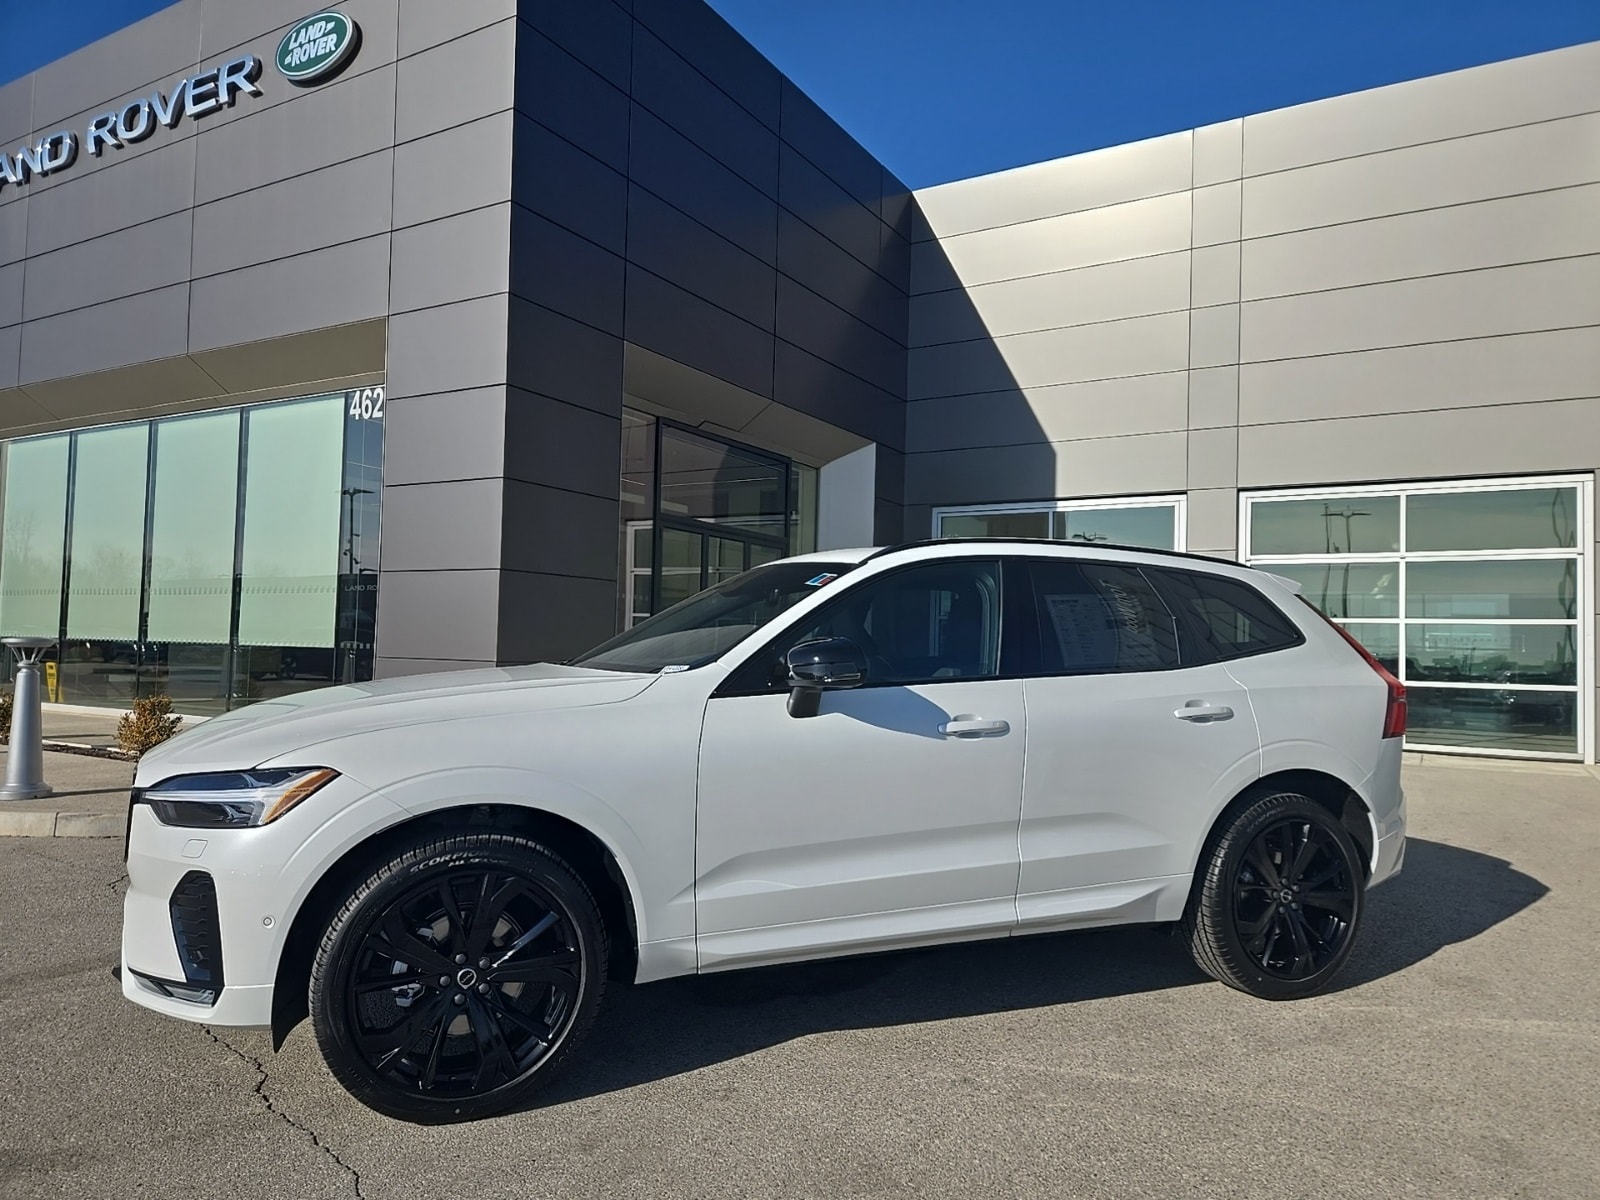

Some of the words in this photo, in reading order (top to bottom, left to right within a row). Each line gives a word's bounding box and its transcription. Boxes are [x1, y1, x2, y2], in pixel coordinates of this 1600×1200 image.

[288, 20, 326, 50] LAND
[291, 33, 338, 67] ROVER
[0, 130, 75, 184] AND
[86, 55, 260, 155] ROVER
[349, 387, 384, 420] 462
